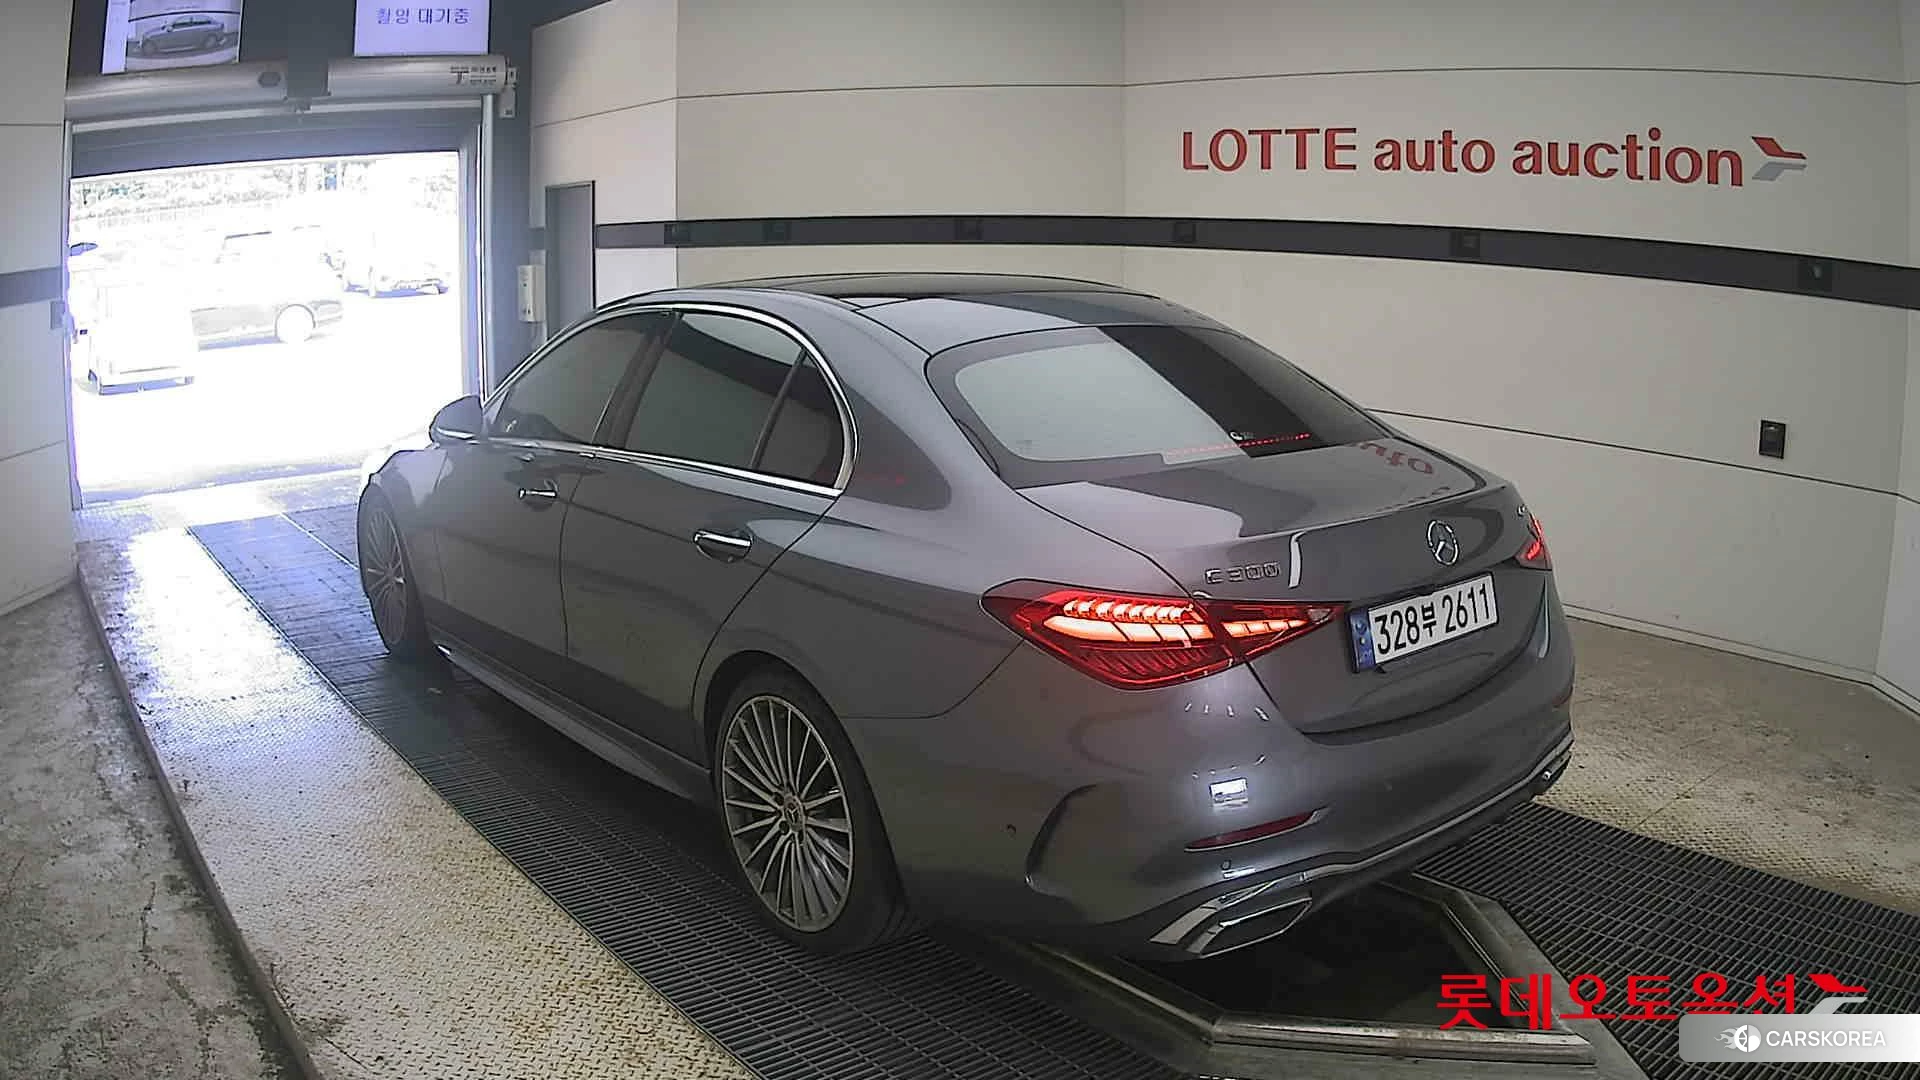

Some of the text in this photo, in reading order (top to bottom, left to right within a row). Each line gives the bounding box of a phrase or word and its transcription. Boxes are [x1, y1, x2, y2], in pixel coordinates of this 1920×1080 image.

[418, 7, 469, 25] 대기중
[1182, 127, 1744, 187] LOTTE auto auction
[1441, 583, 1490, 634] 2611
